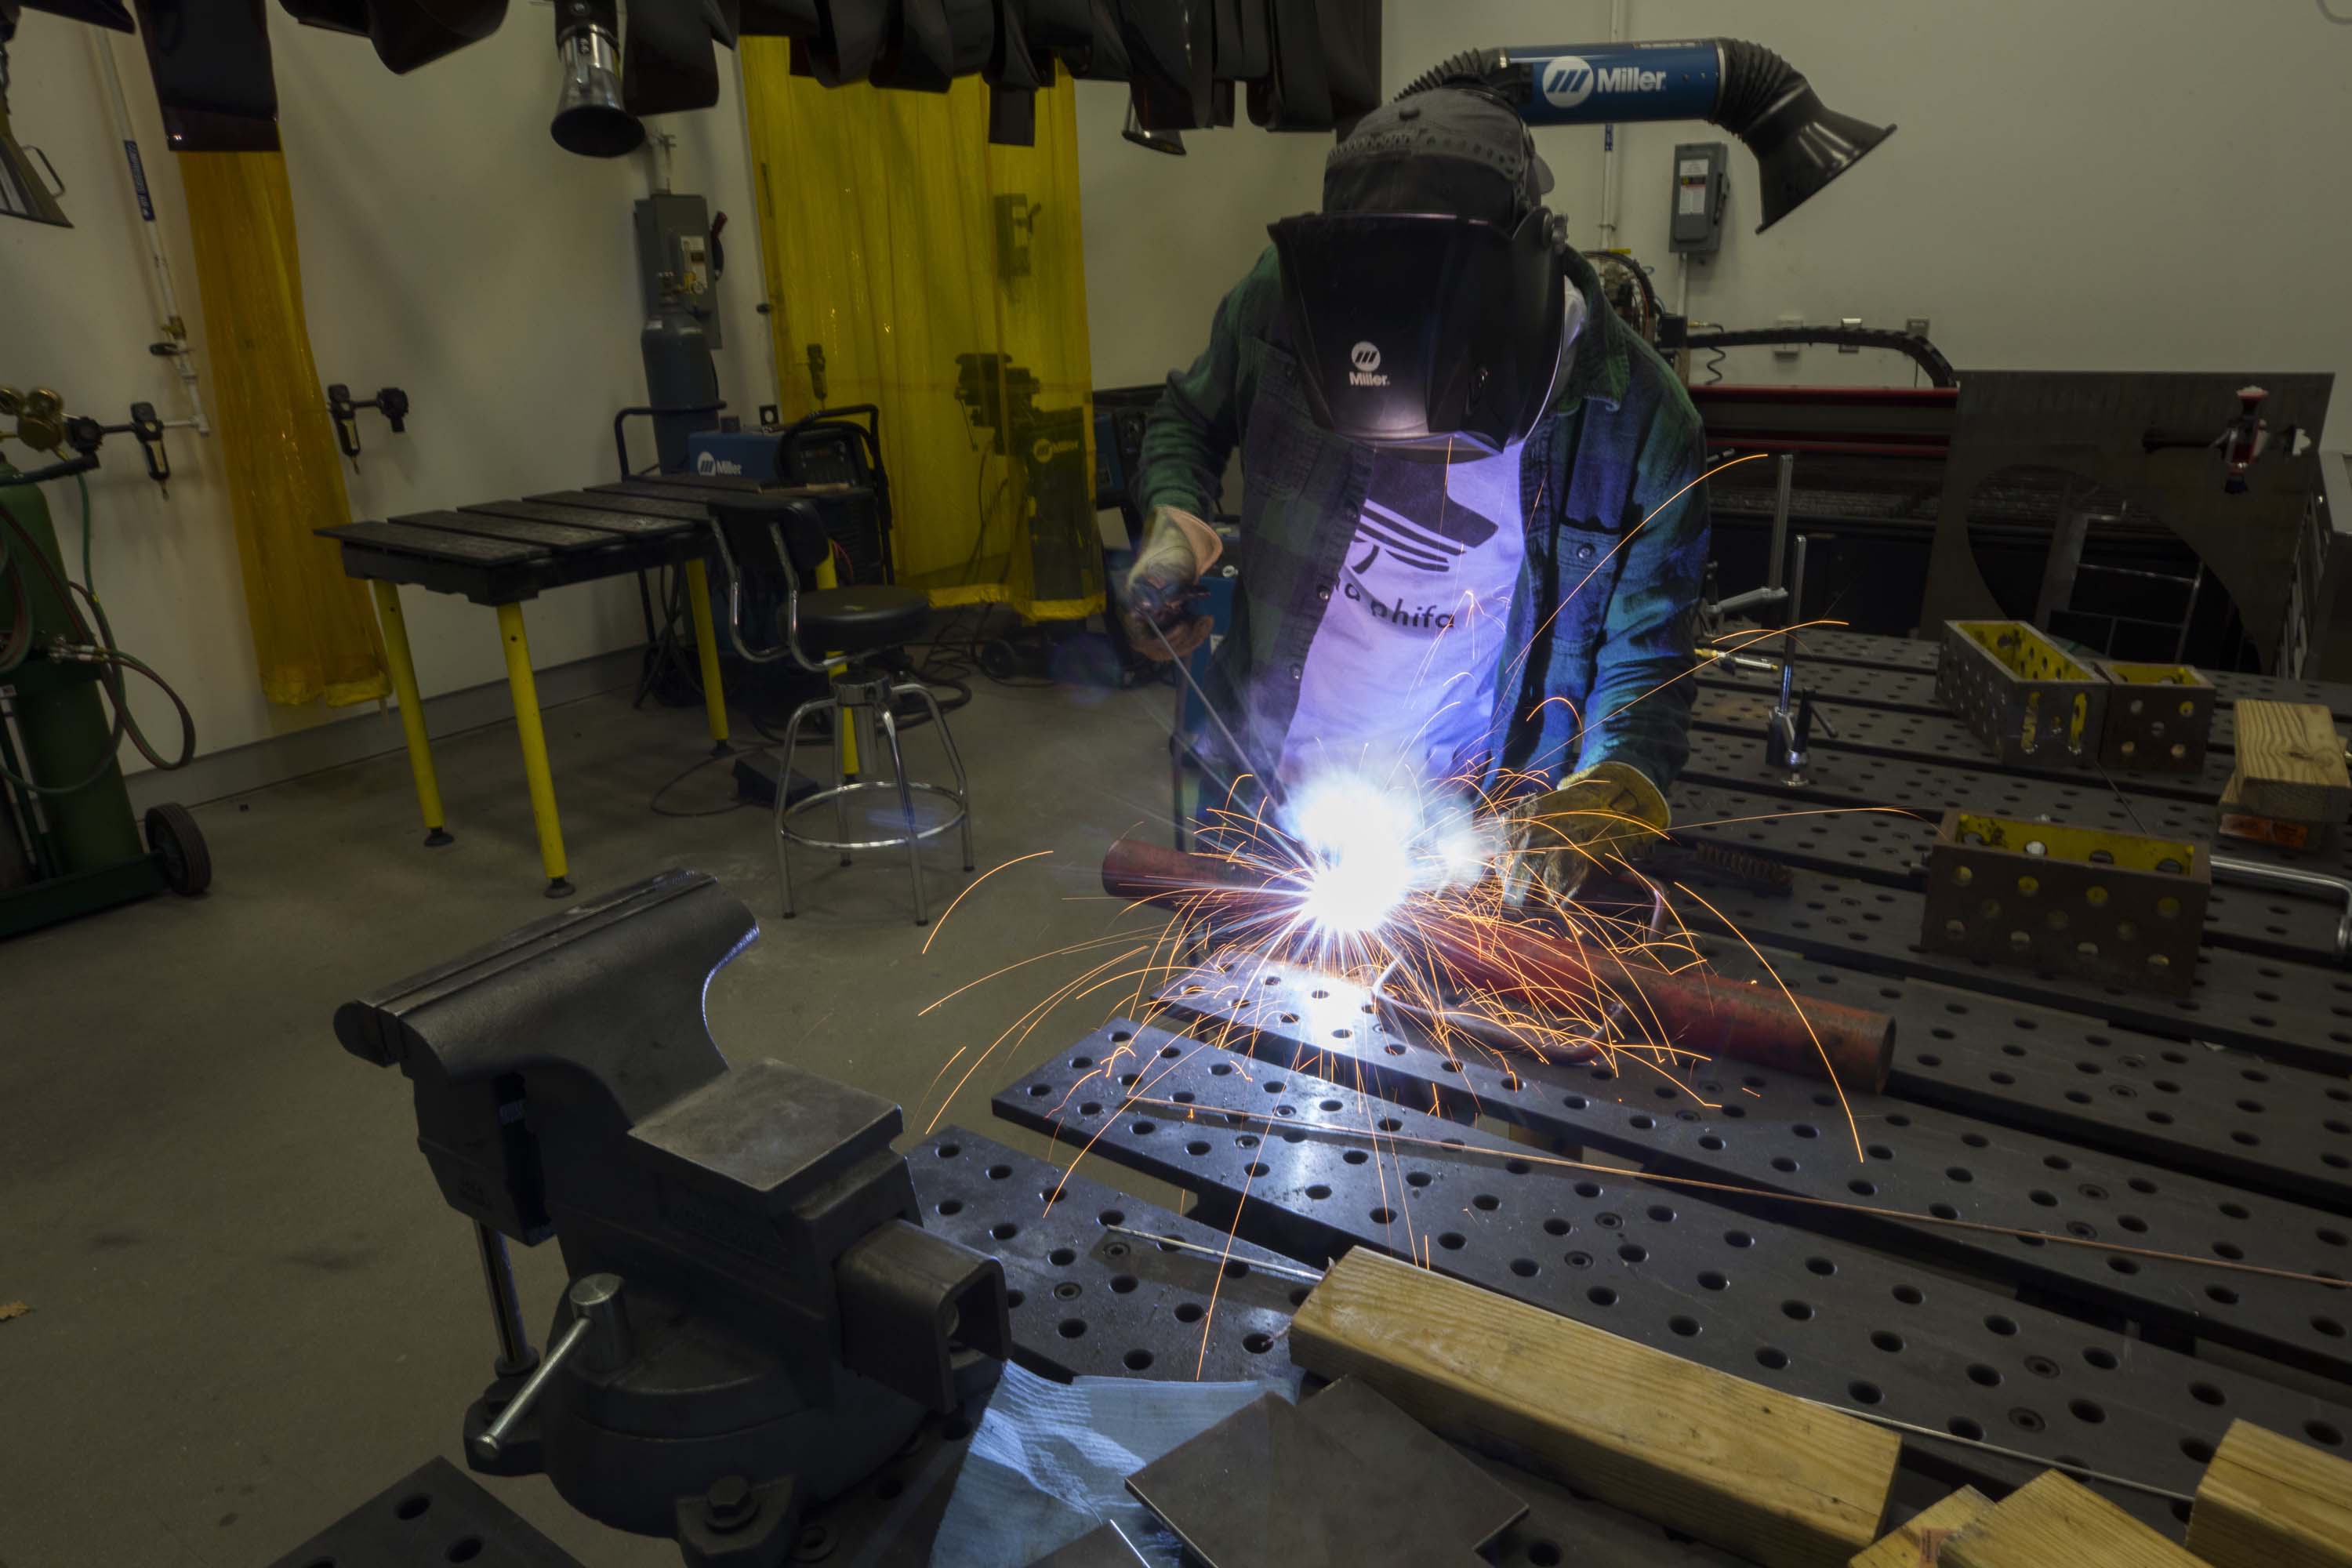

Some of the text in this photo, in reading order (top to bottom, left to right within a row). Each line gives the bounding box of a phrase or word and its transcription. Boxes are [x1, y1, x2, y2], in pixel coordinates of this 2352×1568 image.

[1597, 67, 1667, 93] Miller
[1348, 371, 1388, 387] Miller
[1053, 439, 1080, 453] Miller
[716, 459, 742, 476] Miller
